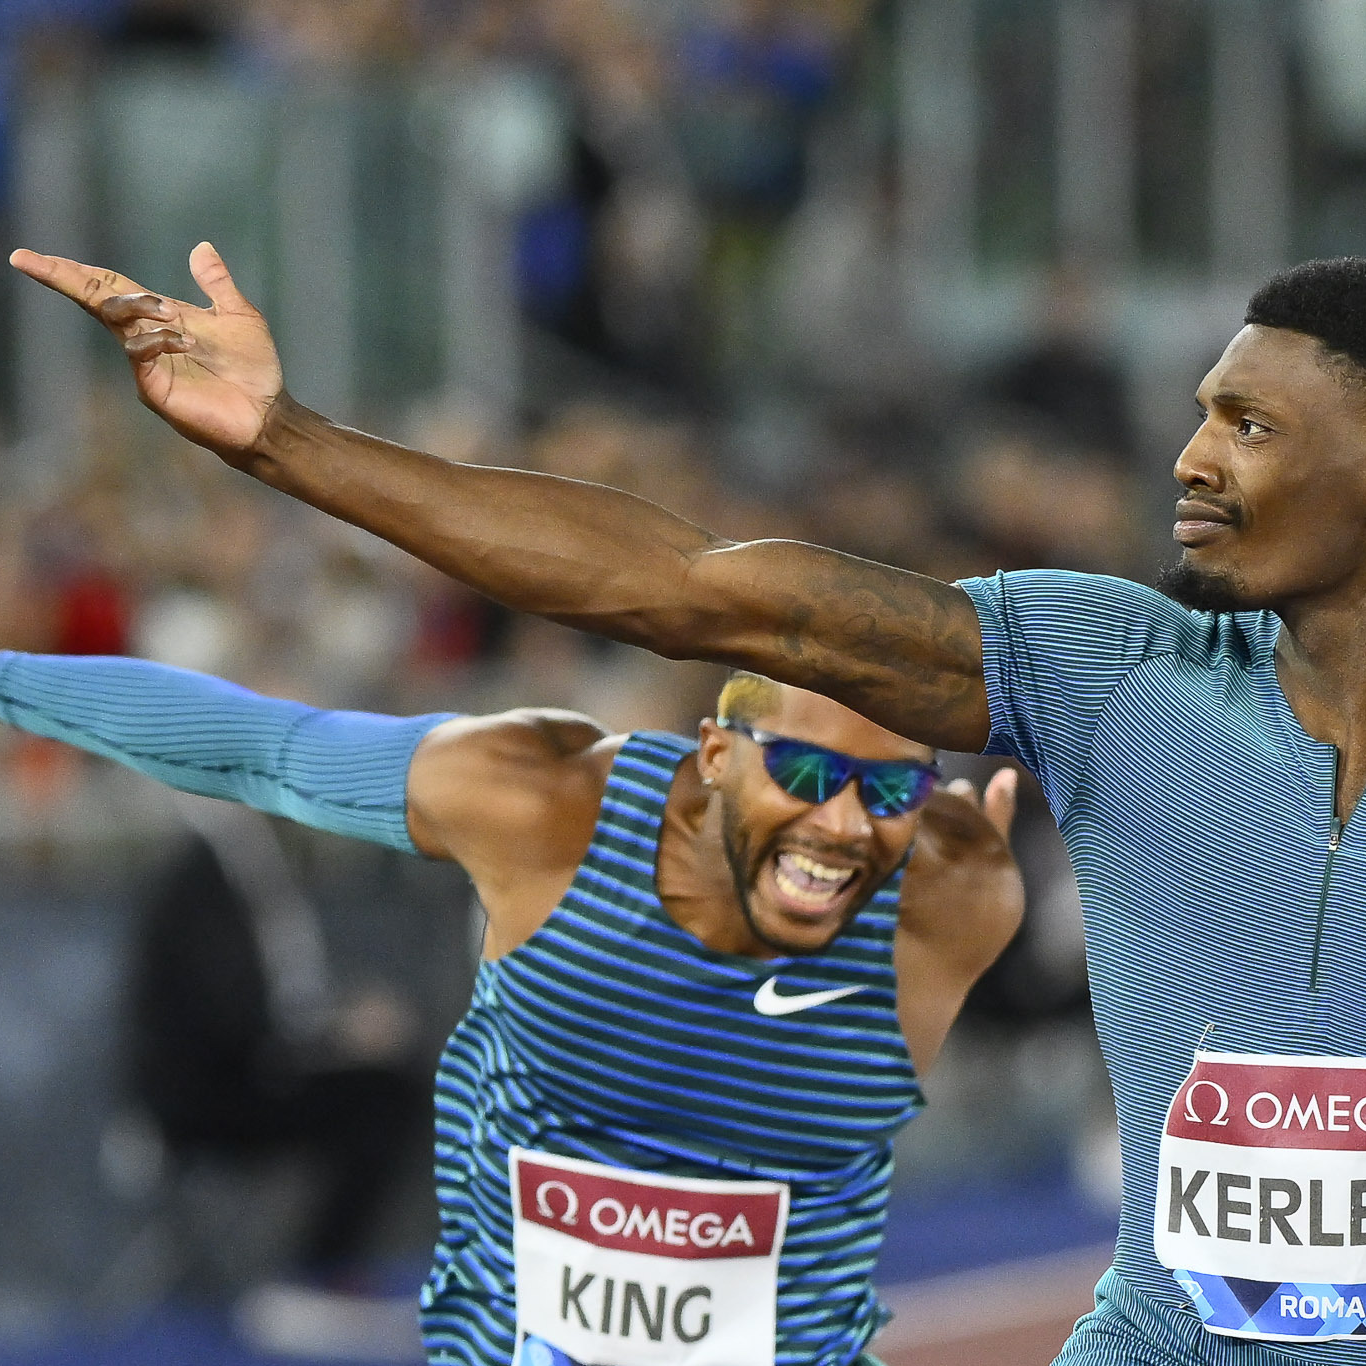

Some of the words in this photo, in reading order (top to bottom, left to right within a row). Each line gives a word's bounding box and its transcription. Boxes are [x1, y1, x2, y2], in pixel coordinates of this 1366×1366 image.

[589, 1197, 755, 1249] OMEGA
[560, 1265, 712, 1343] KING
[1279, 1294, 1366, 1319] ROMA
